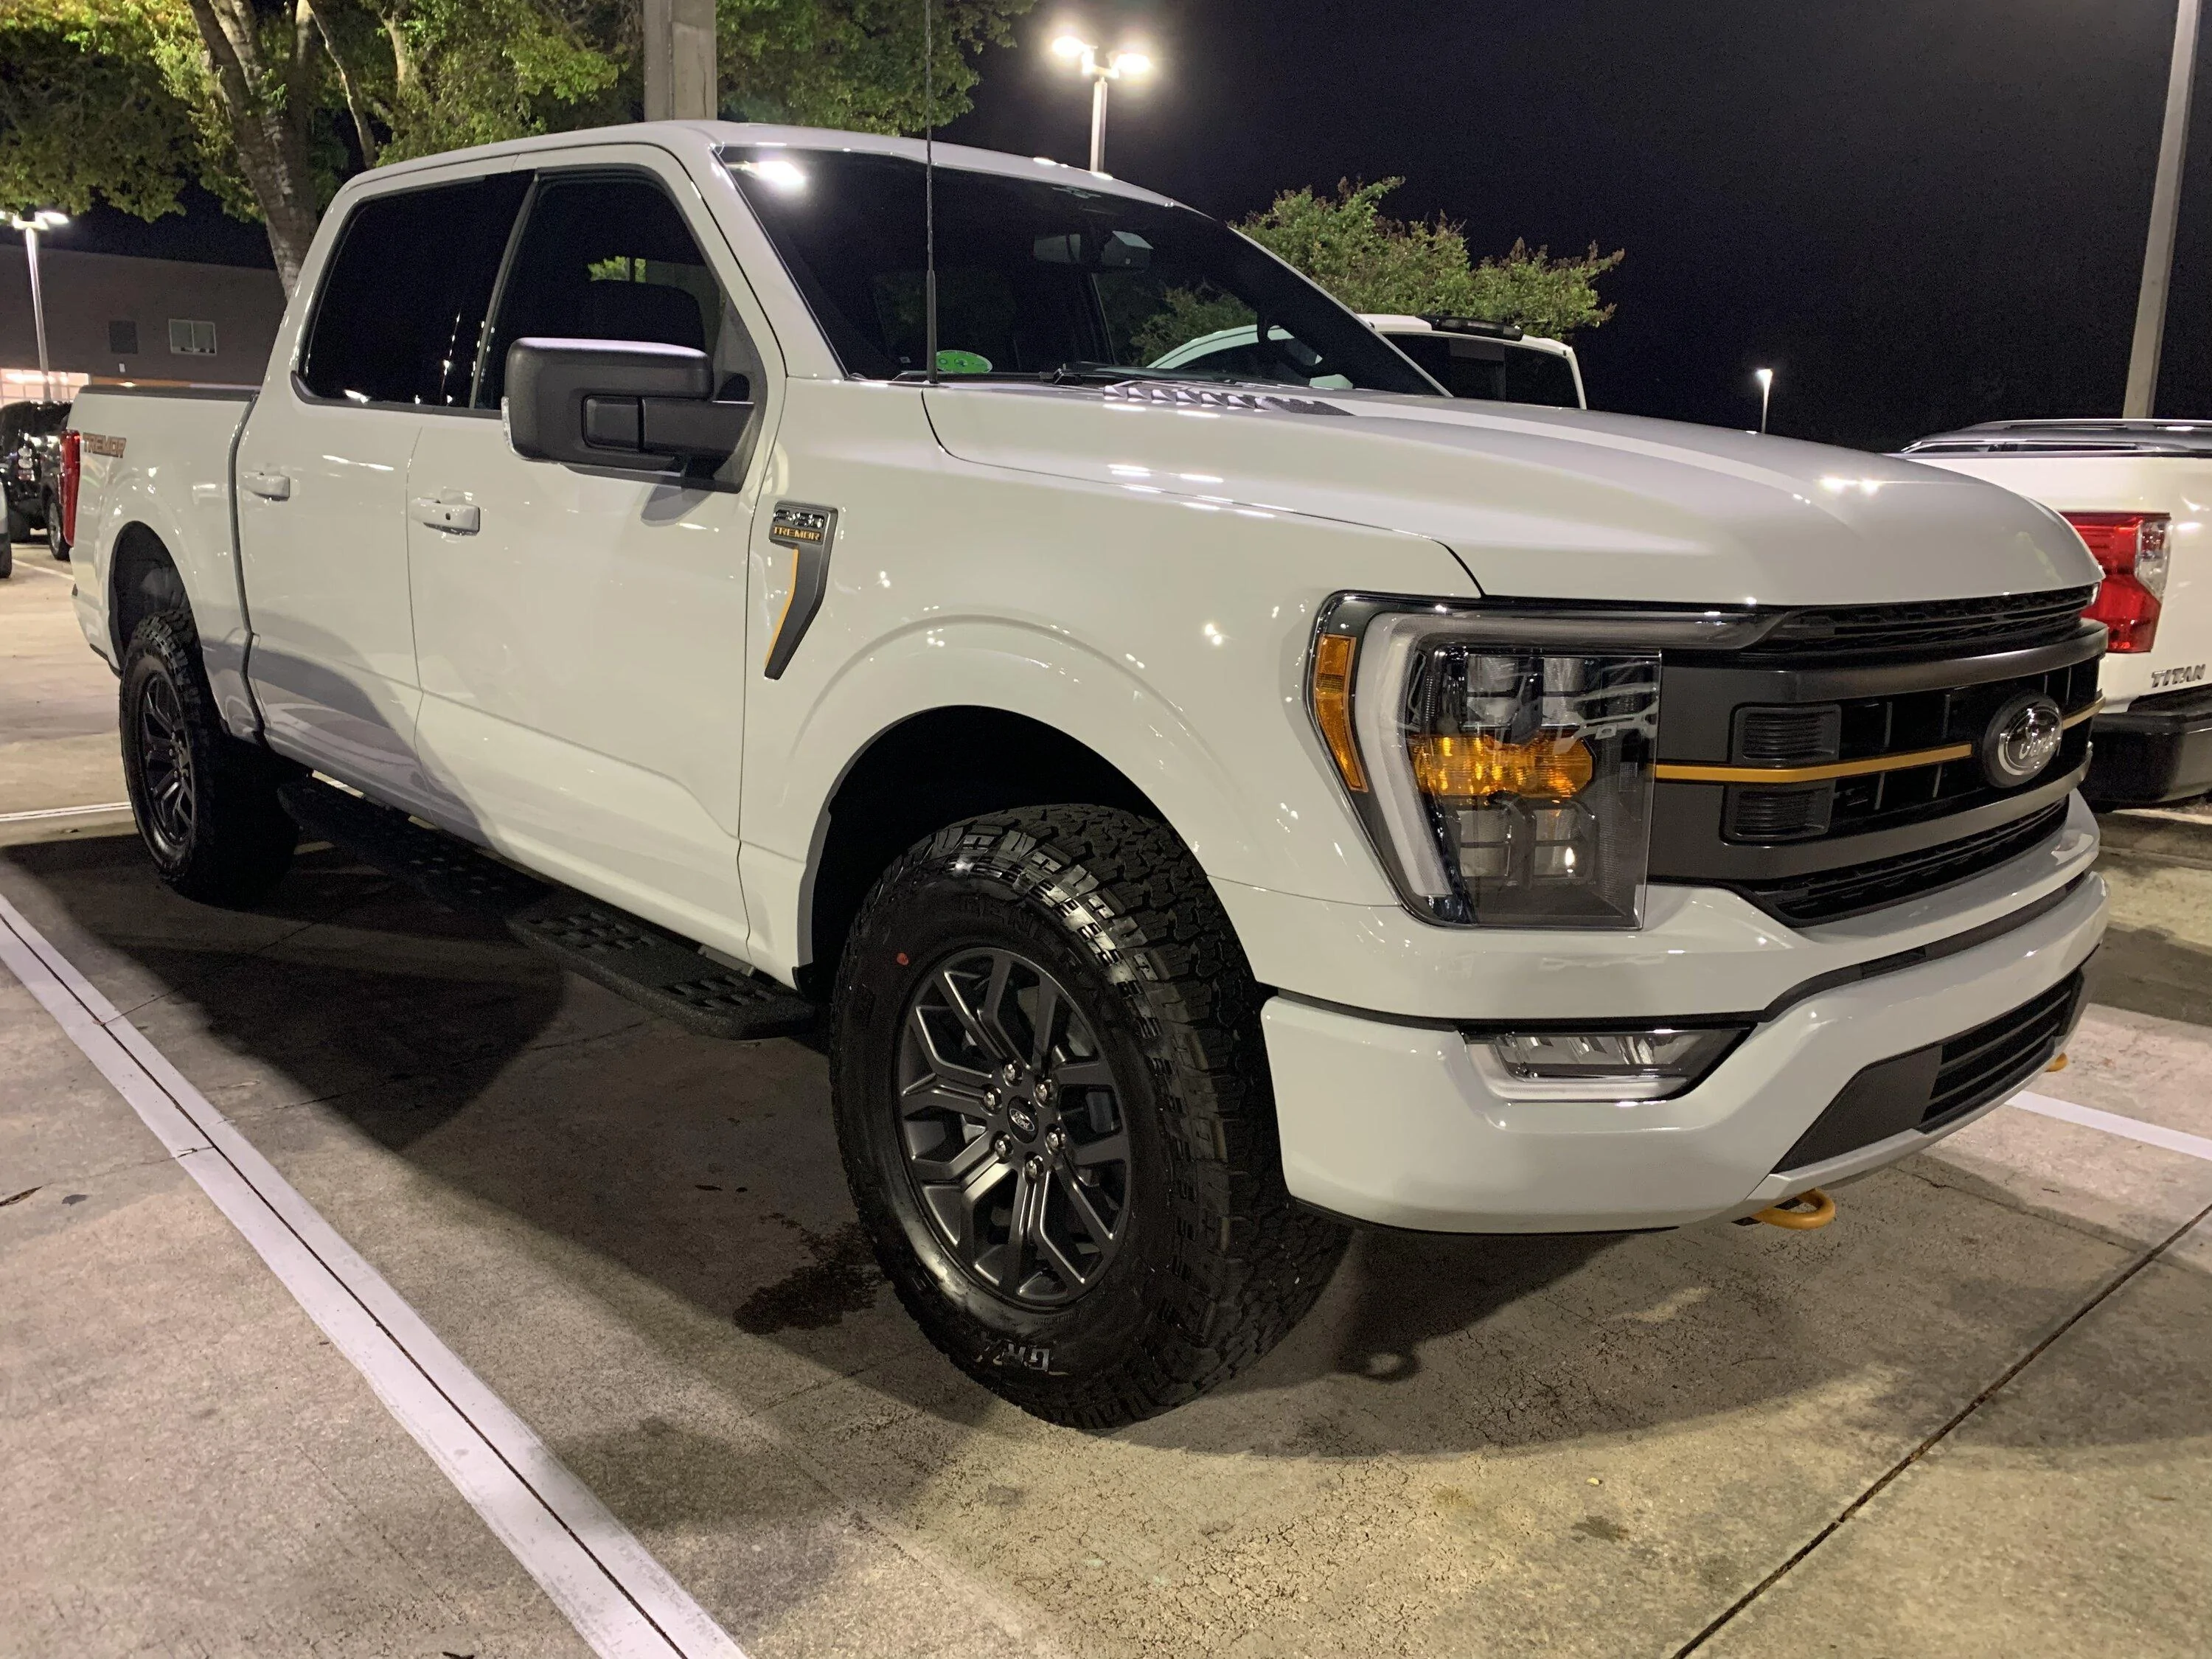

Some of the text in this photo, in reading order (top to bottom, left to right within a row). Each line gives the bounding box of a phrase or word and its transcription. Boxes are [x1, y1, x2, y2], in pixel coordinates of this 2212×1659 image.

[83, 432, 127, 459] TREMOR
[773, 526, 821, 541] TREMOR
[2150, 664, 2206, 689] TITAN
